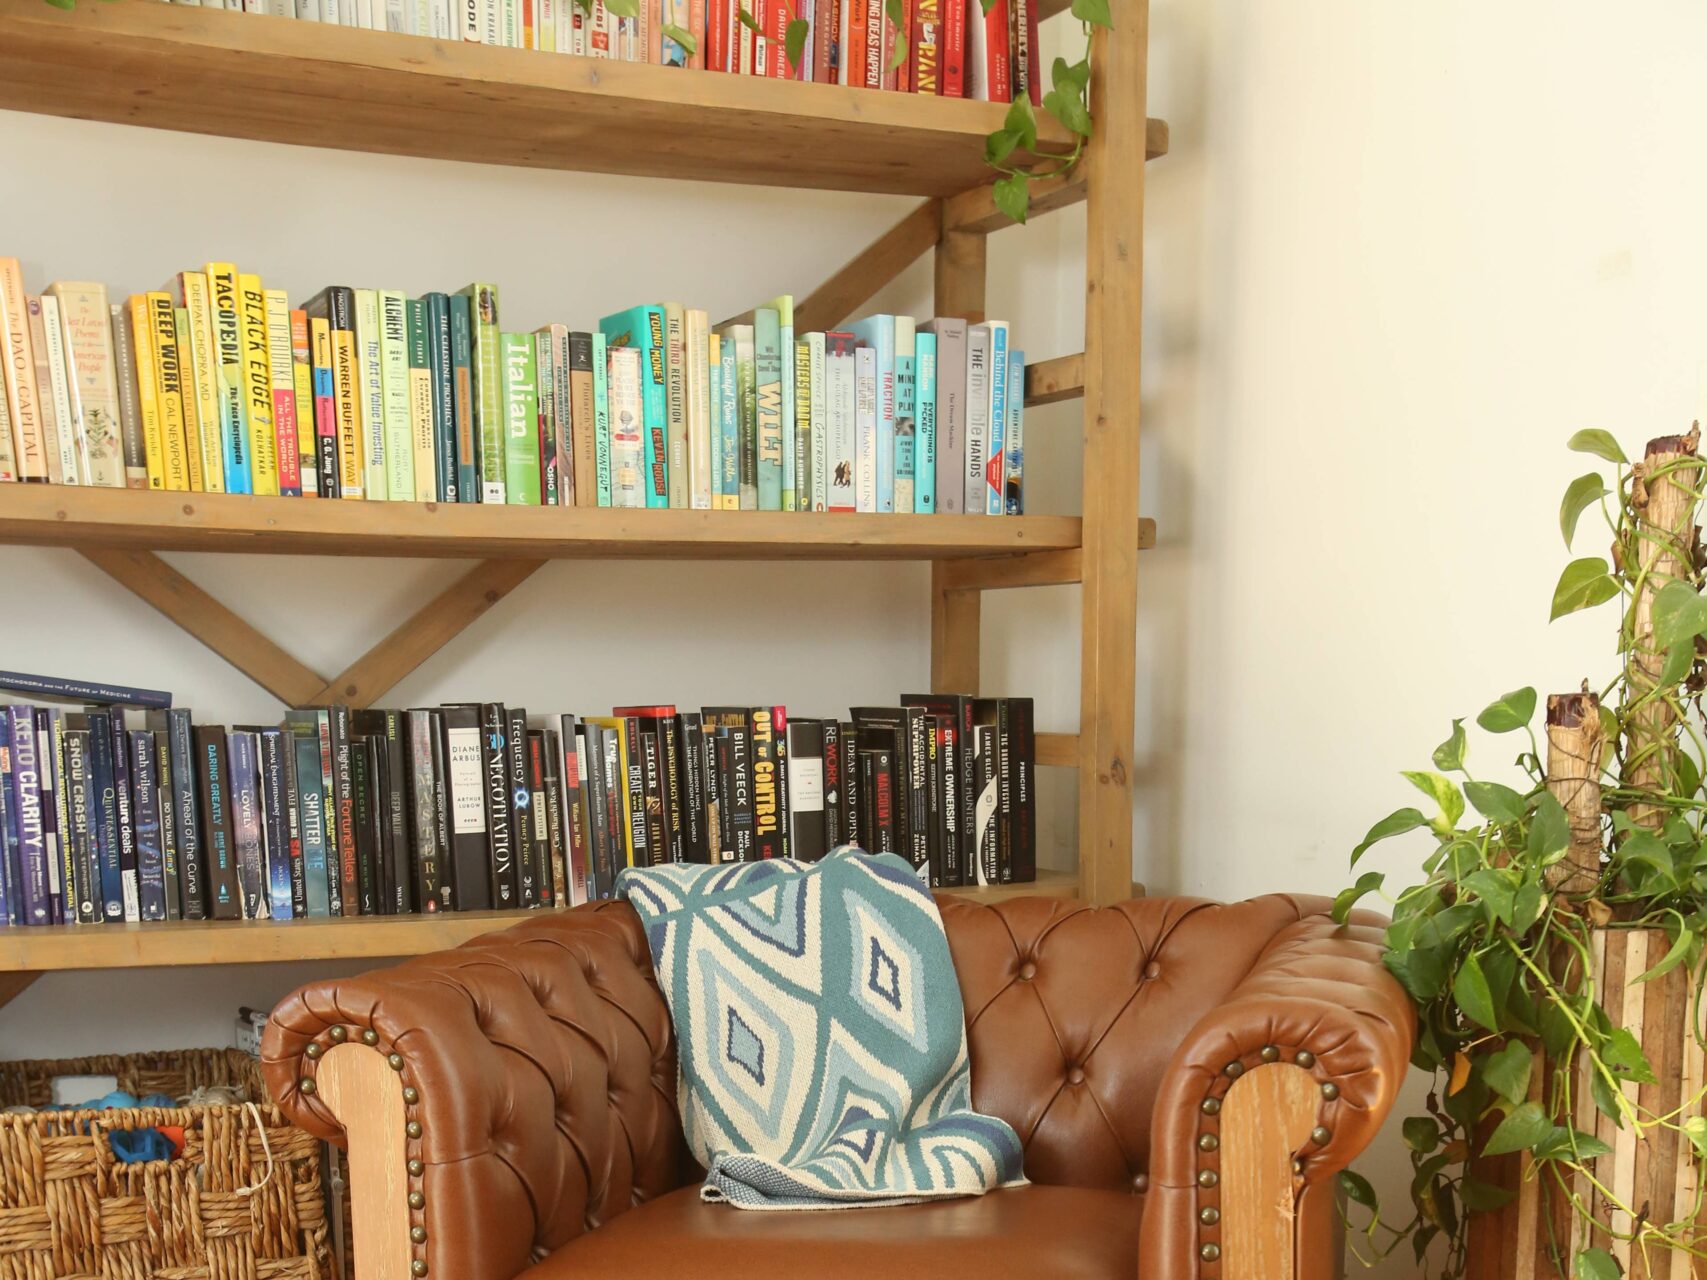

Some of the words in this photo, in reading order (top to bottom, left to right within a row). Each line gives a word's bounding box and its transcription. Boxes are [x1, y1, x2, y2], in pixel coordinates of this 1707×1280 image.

[867, 18, 880, 47] IDEAS
[867, 48, 880, 85] HAPPEN
[156, 299, 174, 339] DEEP
[215, 273, 239, 365] TACOPEDIA
[244, 291, 267, 355] BLACK
[337, 293, 347, 328] HAGSTROM
[384, 296, 404, 342] ALCHEMY
[440, 315, 448, 331] THE
[669, 318, 679, 334] THE
[191, 283, 203, 326] DEEPAK
[201, 383, 210, 401] MD
[650, 314, 662, 347] YOUNG
[368, 341, 379, 358] The
[441, 335, 450, 379] CELESTINE
[670, 338, 680, 364] THIRD
[796, 346, 810, 387] MASTERS
[972, 348, 983, 369] THE
[160, 344, 179, 393] WORK
[339, 345, 351, 401] WARREN
[369, 361, 380, 376] Art
[370, 379, 381, 388] of
[651, 350, 663, 384] MONEY
[722, 355, 735, 397] Beautiful
[994, 350, 1005, 387] Behind
[10, 332, 26, 370] DAO
[18, 386, 38, 463] CAPITAL
[250, 360, 272, 410] EDGE
[507, 342, 533, 439] Italian
[671, 368, 681, 423] REVOLUTION
[883, 371, 893, 421] TRACTION
[903, 389, 912, 398] AT
[994, 390, 1004, 407] the
[165, 397, 177, 420] CAL
[231, 402, 240, 419] Taco
[277, 404, 284, 414] IN
[283, 396, 291, 414] ALL
[371, 392, 383, 417] Value
[444, 382, 452, 427] PROPHECY
[797, 400, 811, 428] DOOM
[278, 417, 286, 435] THE
[285, 417, 293, 435] THE
[342, 402, 355, 456] BUFFETT
[598, 411, 608, 437] KURT
[758, 381, 783, 466] WILT
[926, 402, 934, 454] EVERYTHING
[993, 410, 1004, 442] Cloud
[168, 423, 182, 481] NEWPORT
[280, 437, 289, 473] WORLD
[287, 438, 296, 481] TROUBLE
[371, 421, 385, 466] Investing
[652, 429, 664, 462] KEVIN
[862, 426, 871, 460] FRANK
[970, 439, 981, 478] HANDS
[324, 455, 333, 474] Jung
[345, 459, 356, 484] WAY
[546, 467, 555, 490] OSHO
[598, 441, 609, 492] VONNEGUT
[653, 464, 666, 495] ROOSE
[862, 464, 871, 507] COLLINS
[387, 715, 396, 741] CARLISLE
[753, 711, 772, 742] OUT
[984, 732, 992, 755] JAMES
[53, 719, 65, 776] TECHNOLOGICAL
[69, 737, 83, 781] SNOW
[138, 740, 149, 767] sarah
[338, 745, 349, 769] Plight
[511, 719, 525, 784] frequency
[609, 739, 618, 763] True
[734, 732, 744, 760] BILL
[757, 746, 767, 758] OF
[777, 739, 785, 757] 365
[826, 727, 838, 786] REWORK
[847, 740, 856, 773] IDEAS
[912, 717, 920, 789] SUPERPOWER
[928, 728, 936, 760] IMPRO
[944, 729, 954, 771] EXTREME
[207, 744, 218, 781] DARING
[340, 770, 350, 780] of
[629, 765, 642, 794] CREATE
[646, 747, 656, 789] TIGER
[964, 748, 973, 783] HEDGE
[118, 779, 130, 823] venture
[139, 770, 150, 803] wilson
[341, 782, 351, 799] the
[709, 770, 717, 799] LYNCH
[735, 763, 747, 806] VEECK
[754, 761, 777, 836] CONTROL
[848, 779, 857, 805] AND
[877, 773, 891, 818] MALCOLM
[19, 771, 42, 847] CLARITY
[73, 785, 86, 833] CRASH
[163, 802, 171, 813] DO
[182, 790, 192, 825] Ahead
[210, 783, 222, 825] GREATLY
[241, 789, 251, 829] LOVELY
[303, 793, 320, 845] SHATTER
[437, 812, 444, 822] OF
[488, 753, 511, 873] NEGOTIATION
[945, 774, 956, 832] OWNERSHIP
[965, 787, 975, 835] HUNTERS
[61, 827, 69, 843] AND
[102, 787, 118, 869] QUINTESSENTIAL
[164, 814, 172, 829] YOU
[165, 830, 173, 846] TALK
[184, 828, 194, 839] of
[341, 800, 353, 844] Fortune
[438, 823, 446, 846] ALBERT
[633, 812, 646, 848] RELIGION
[672, 812, 680, 832] RISK
[121, 826, 133, 854] deals
[185, 842, 195, 860] the
[989, 830, 997, 878] INFORMATION
[63, 844, 72, 879] FINANCIAL
[187, 863, 198, 893] Curve
[344, 846, 355, 882] Tellers
[65, 881, 74, 909] CAPITAL
